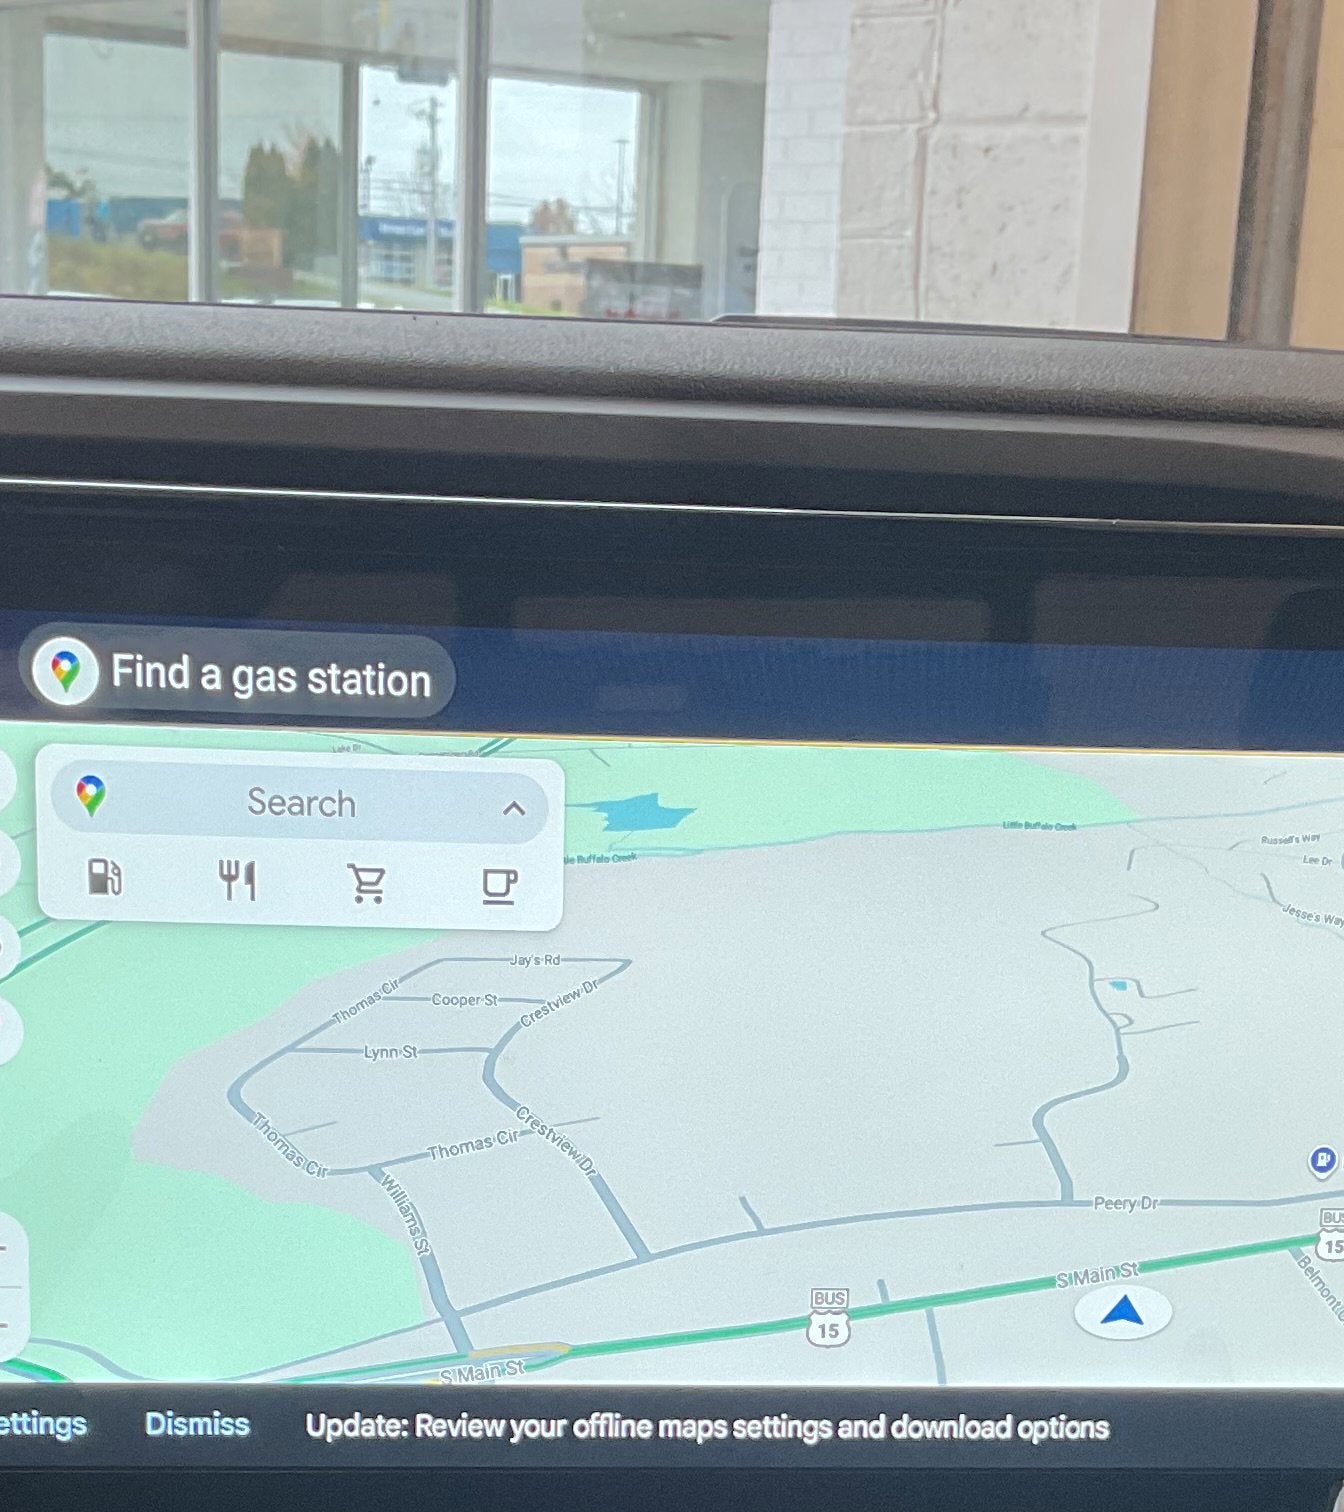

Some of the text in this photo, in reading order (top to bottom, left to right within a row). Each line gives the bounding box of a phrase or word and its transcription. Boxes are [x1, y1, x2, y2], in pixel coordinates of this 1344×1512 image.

[112, 652, 432, 700] Find a gas station
[247, 786, 356, 818] Search
[1282, 903, 1321, 922] Jesse's
[509, 954, 560, 968] Jay's Rd
[331, 990, 382, 1025] Thomas
[431, 993, 498, 1008] Cooper St
[520, 978, 599, 1028] Crestview Dr
[363, 1045, 418, 1060] Lynn St
[252, 1111, 329, 1179] Thomas Cir
[426, 1129, 520, 1161] Thomas Cir
[516, 1106, 598, 1177] Crestview Dr
[380, 1173, 432, 1257] Williams St
[1094, 1195, 1159, 1214] Peery Dr
[1325, 1240, 1344, 1254] 15
[1056, 1260, 1139, 1289] S Main St
[1297, 1255, 1342, 1312] Belmont
[814, 1291, 846, 1306] BUS
[818, 1322, 840, 1339] 15
[440, 1359, 526, 1385] S Main St
[144, 1410, 251, 1437] Dismiss
[305, 1412, 1111, 1446] Update: Review your offline maps settings and download options
